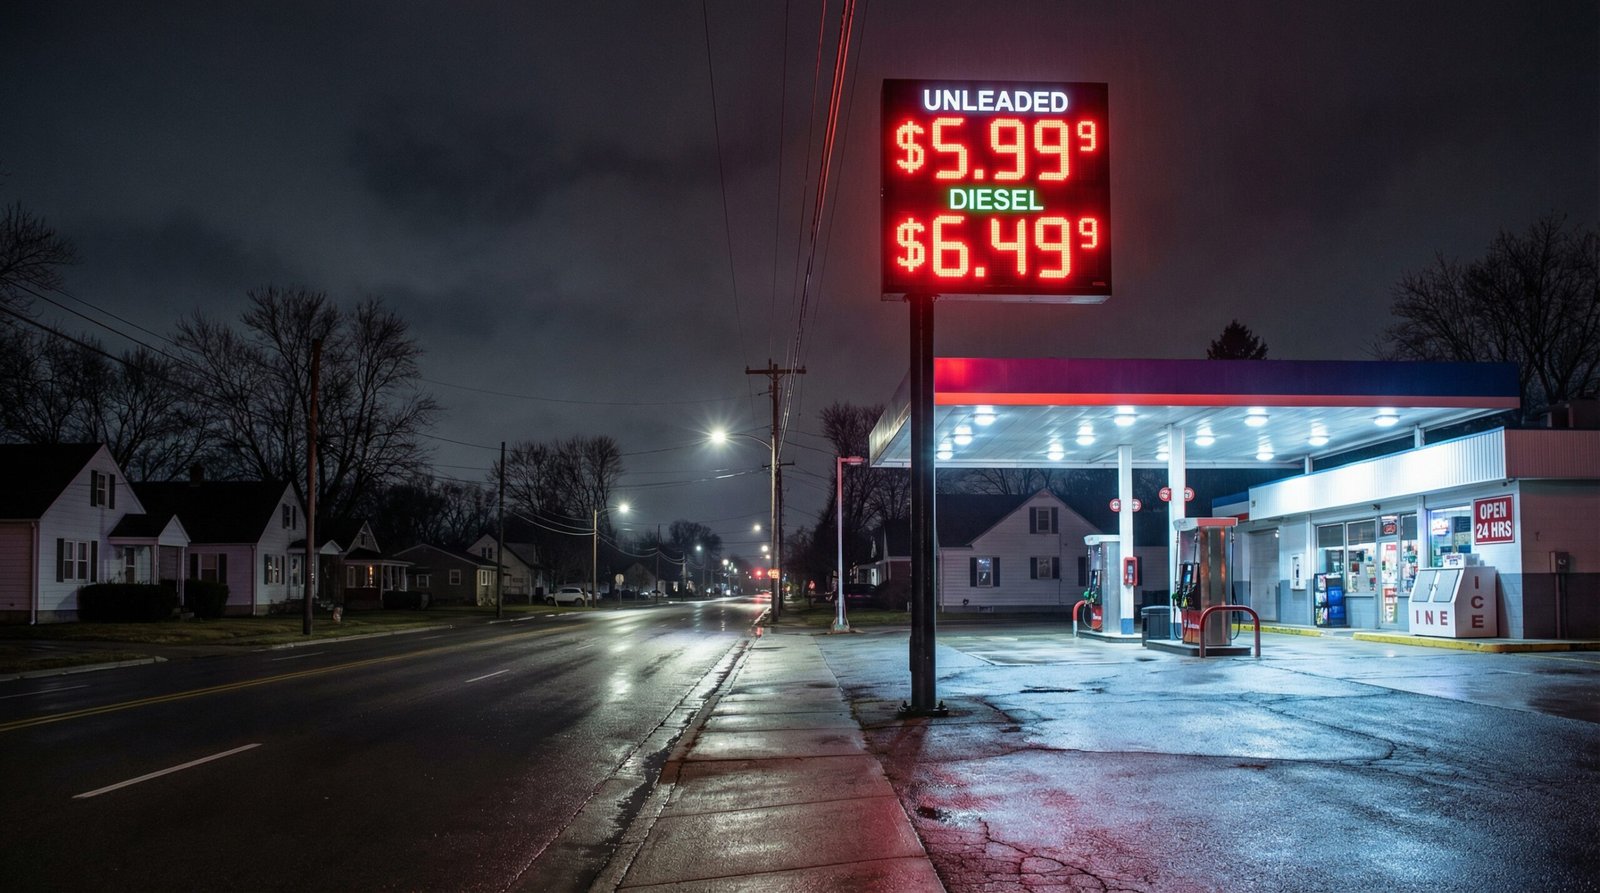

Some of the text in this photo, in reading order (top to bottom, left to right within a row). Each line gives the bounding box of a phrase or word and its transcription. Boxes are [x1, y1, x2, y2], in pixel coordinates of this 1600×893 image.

[924, 89, 1068, 112] UNLEADED
[949, 189, 1044, 211] DIESEL
[1480, 502, 1506, 520] OPEN
[1476, 520, 1512, 539] 24 HRS
[1471, 576, 1484, 629] ICE
